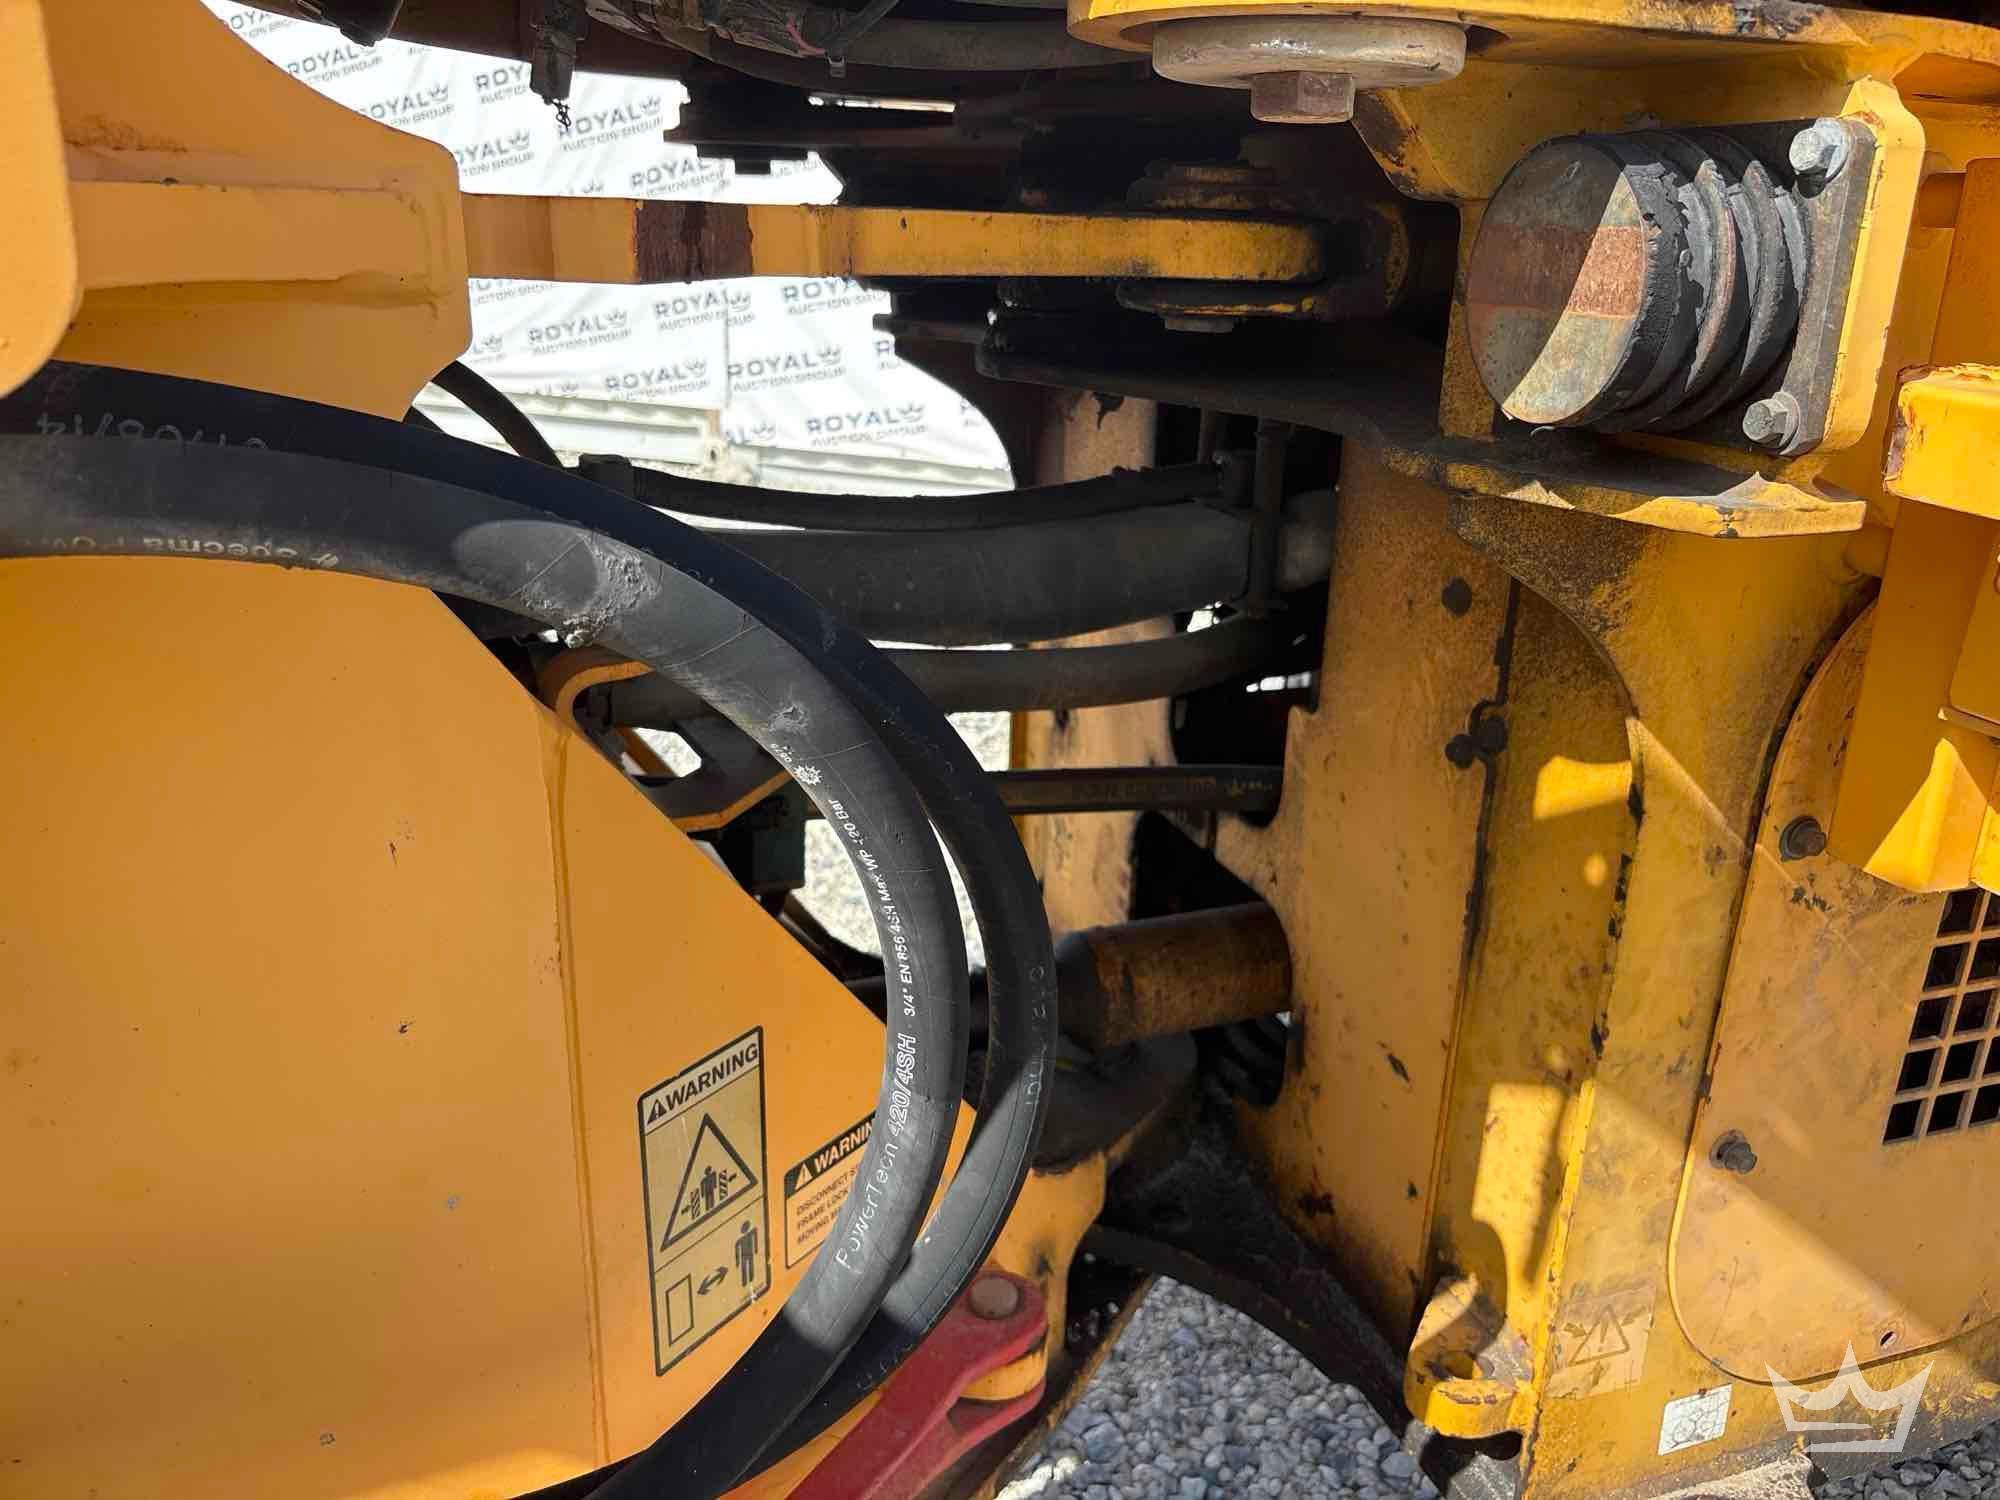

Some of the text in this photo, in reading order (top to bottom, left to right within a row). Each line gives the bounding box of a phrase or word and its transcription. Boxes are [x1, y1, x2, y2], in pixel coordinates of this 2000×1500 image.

[368, 91, 429, 119] OYAL
[529, 314, 607, 342] ROYAL
[728, 349, 817, 377] ROYAL
[605, 363, 689, 392] ROYAL
[806, 407, 901, 435] ROYAL
[828, 799, 850, 820] Bar
[859, 849, 879, 871] WP
[900, 964, 912, 985] EN
[665, 1041, 759, 1113] WARNING
[887, 1032, 917, 1138] 420/4SH
[813, 1120, 873, 1174] WARNIN
[835, 1142, 898, 1269] PowerTech
